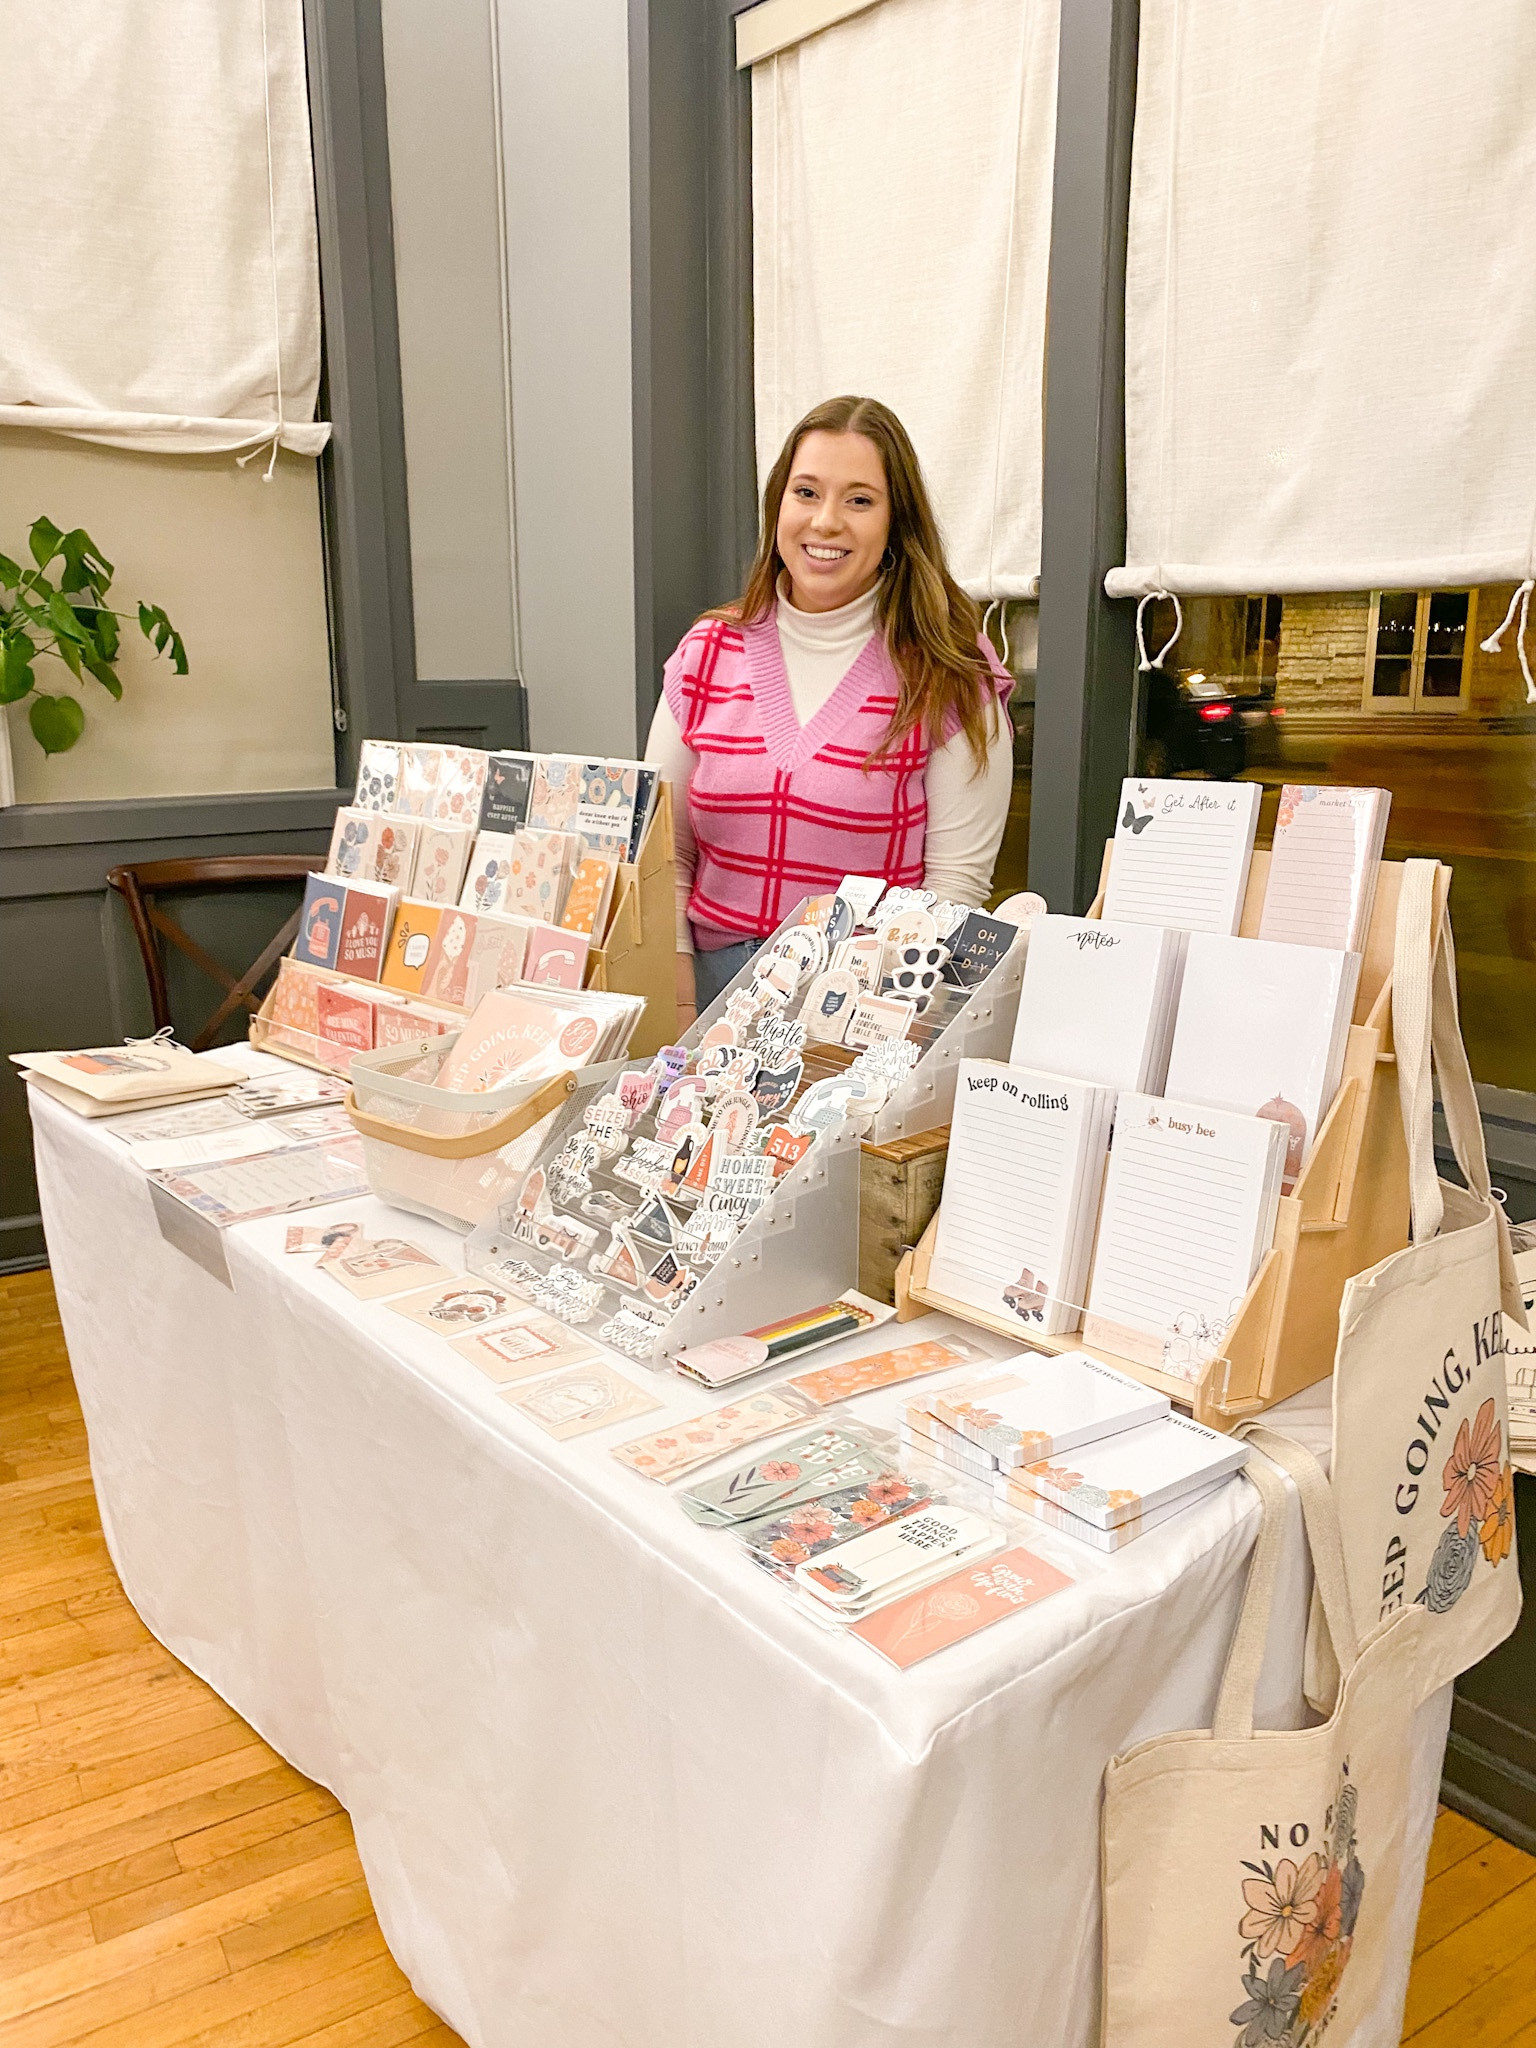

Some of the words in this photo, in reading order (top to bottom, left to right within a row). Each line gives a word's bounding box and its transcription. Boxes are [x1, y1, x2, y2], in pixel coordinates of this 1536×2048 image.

[1162, 794, 1185, 814] Get
[1189, 795, 1220, 811] After
[888, 889, 933, 903] GOOD
[804, 903, 843, 923] SUNNY
[349, 938, 364, 949] LOVE
[887, 927, 900, 941] Be
[977, 929, 997, 943] OH
[1066, 930, 1120, 950] notes
[344, 949, 356, 961] SO
[356, 948, 377, 960] MUSH
[851, 956, 862, 966] be
[961, 941, 1003, 962] HAPPY
[961, 958, 988, 974] DAY
[860, 1012, 874, 1020] MAKE
[759, 1017, 803, 1047] Hustle
[852, 1027, 871, 1037] SMILE
[875, 1033, 889, 1041] TODA
[748, 1038, 789, 1069] Hard
[967, 1077, 998, 1092] keep
[1002, 1081, 1018, 1097] on
[1021, 1094, 1069, 1111] rolling
[585, 1107, 622, 1124] SEIZE
[589, 1124, 612, 1138] THE
[1168, 1117, 1193, 1135] busy
[1196, 1123, 1216, 1138] bee
[565, 1138, 579, 1154] Be
[636, 1138, 673, 1159] PURPOS
[770, 1137, 800, 1160] 513
[562, 1155, 585, 1177] GIRL
[720, 1159, 763, 1175] HOME
[714, 1178, 763, 1194] SWEET
[709, 1194, 749, 1221] Cincy
[1163, 1415, 1220, 1440] EWORTHY
[1379, 1535, 1408, 1622] EEP
[1395, 1348, 1471, 1516] GOING,
[912, 1519, 956, 1542] THINGS
[923, 1517, 958, 1534] GOOD
[898, 1533, 933, 1550] HERE
[901, 1524, 950, 1549] HAPPEN
[1260, 1822, 1310, 1850] NO
